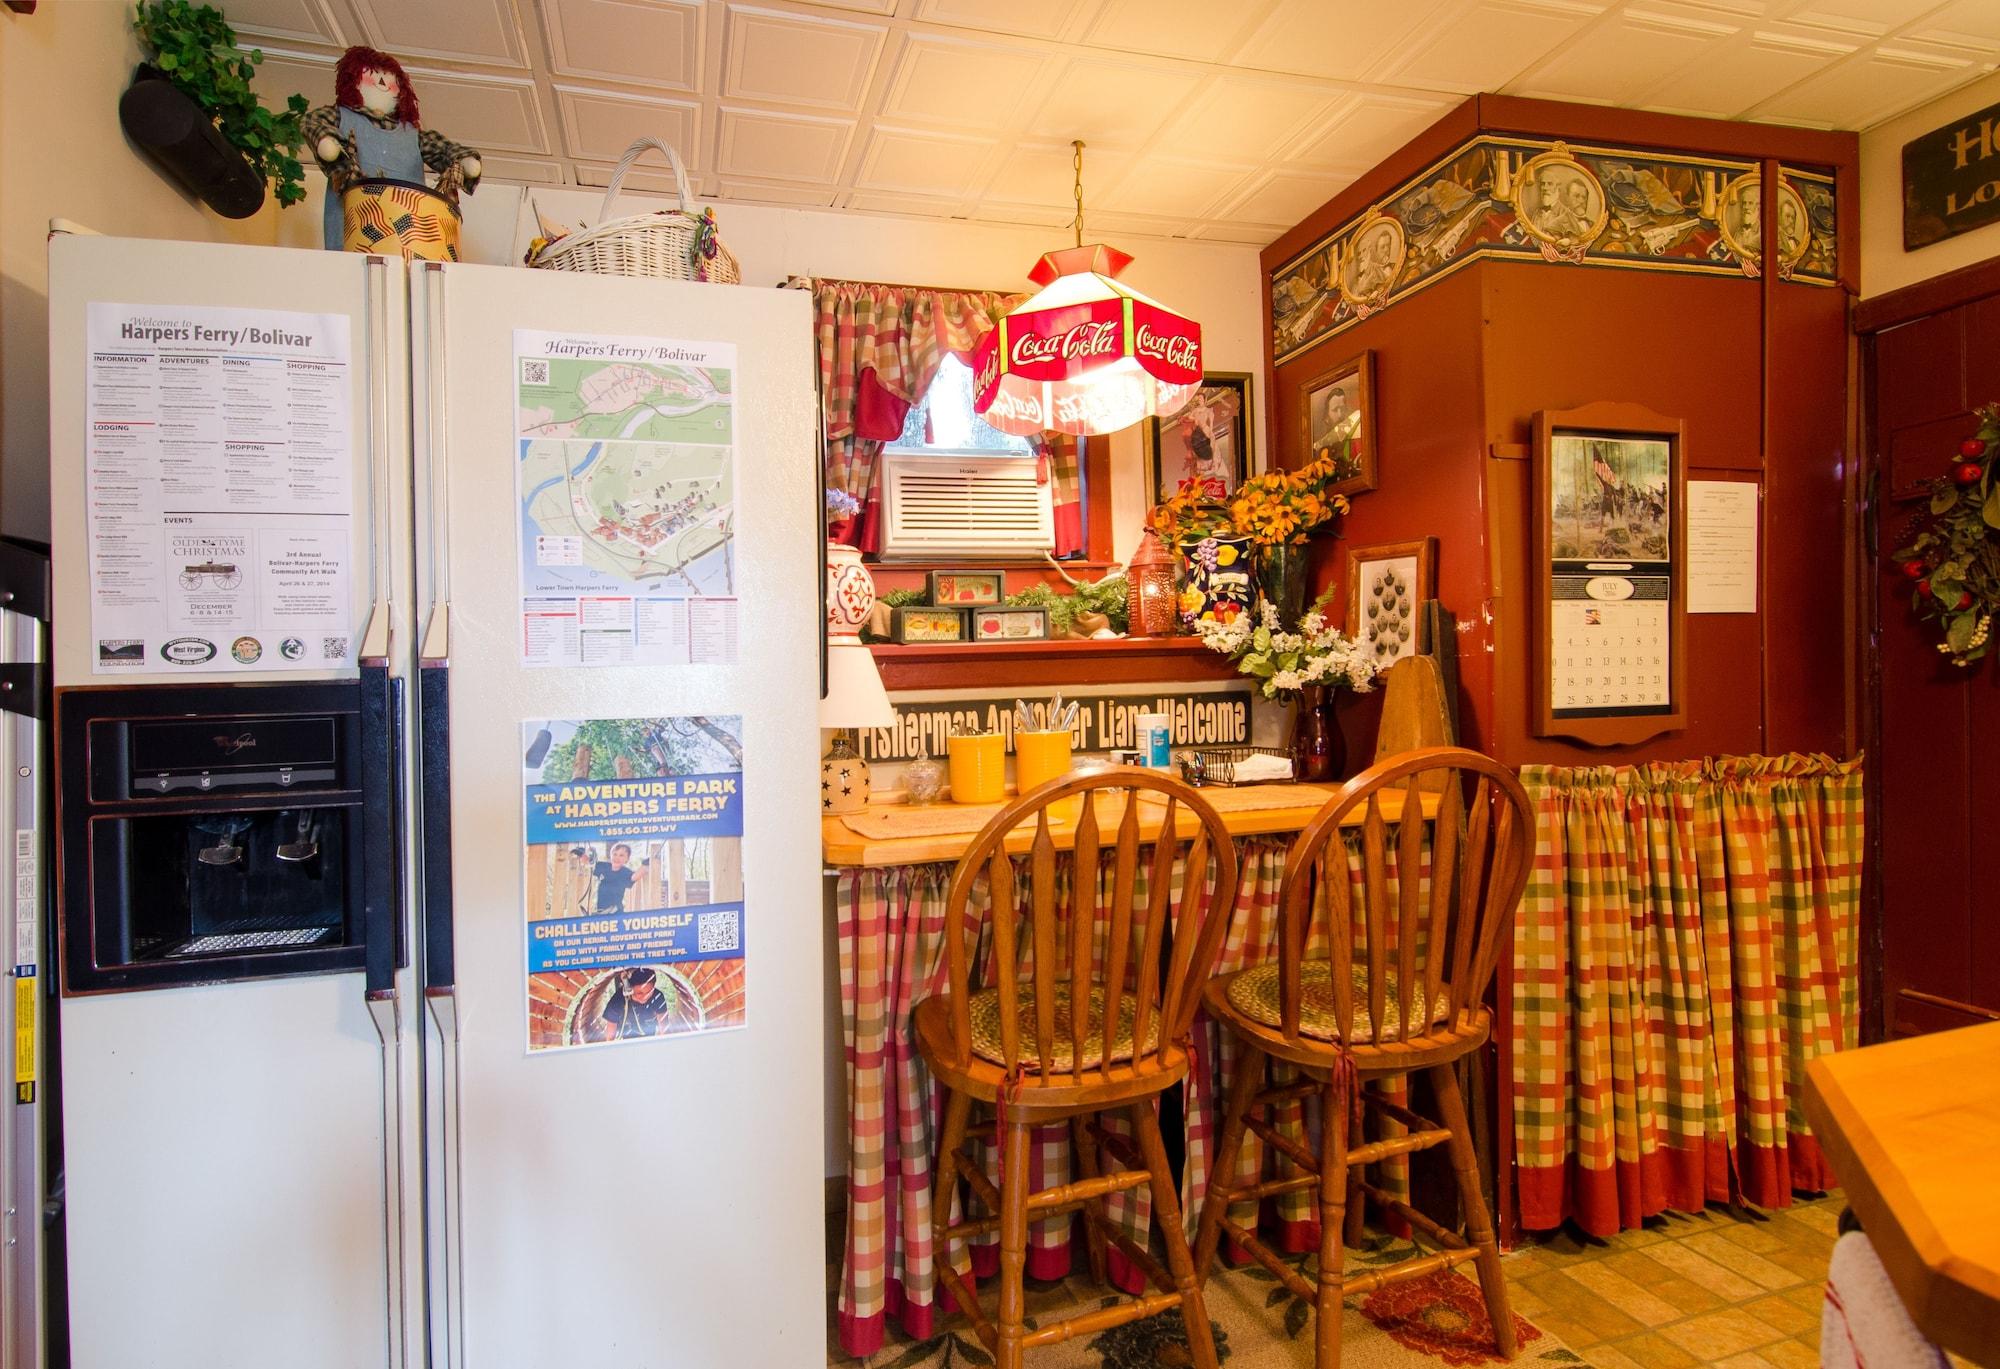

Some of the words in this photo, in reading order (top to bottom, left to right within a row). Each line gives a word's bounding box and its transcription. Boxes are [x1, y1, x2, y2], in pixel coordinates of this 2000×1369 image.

[1948, 117, 2000, 171] H
[130, 317, 178, 327] Welcome
[182, 319, 192, 328] to
[121, 323, 189, 343] Harpers
[545, 340, 605, 358] Harpers
[160, 357, 209, 365] ADVENTURES
[287, 362, 326, 371] SHOPPING
[173, 547, 246, 556] CHRISTMAS
[1099, 700, 1150, 748] Liar
[533, 793, 556, 803] THE
[559, 781, 677, 801] ADVENTURE
[683, 778, 737, 795] PARK
[545, 805, 561, 814] AT
[565, 799, 659, 818] HARPERS
[666, 795, 729, 812] FERRY
[535, 919, 618, 939] CHALLENGE
[622, 912, 694, 931] YOURSELF
[553, 939, 564, 947] ON
[566, 938, 581, 946] OUR
[610, 932, 653, 942] ADVENTURE
[653, 929, 675, 938] PARK!
[542, 960, 553, 968] AS
[555, 959, 570, 967] YOU
[571, 957, 594, 966] CLIMB
[596, 953, 629, 963] THROUGH
[631, 951, 645, 959] THE
[647, 949, 665, 958] TREE
[667, 947, 688, 956] TOPS.
[556, 948, 577, 957] BOND
[578, 946, 597, 955] WITH
[599, 943, 625, 953] FAMILY
[626, 942, 641, 950] AND
[643, 940, 673, 948] FRIENDS
